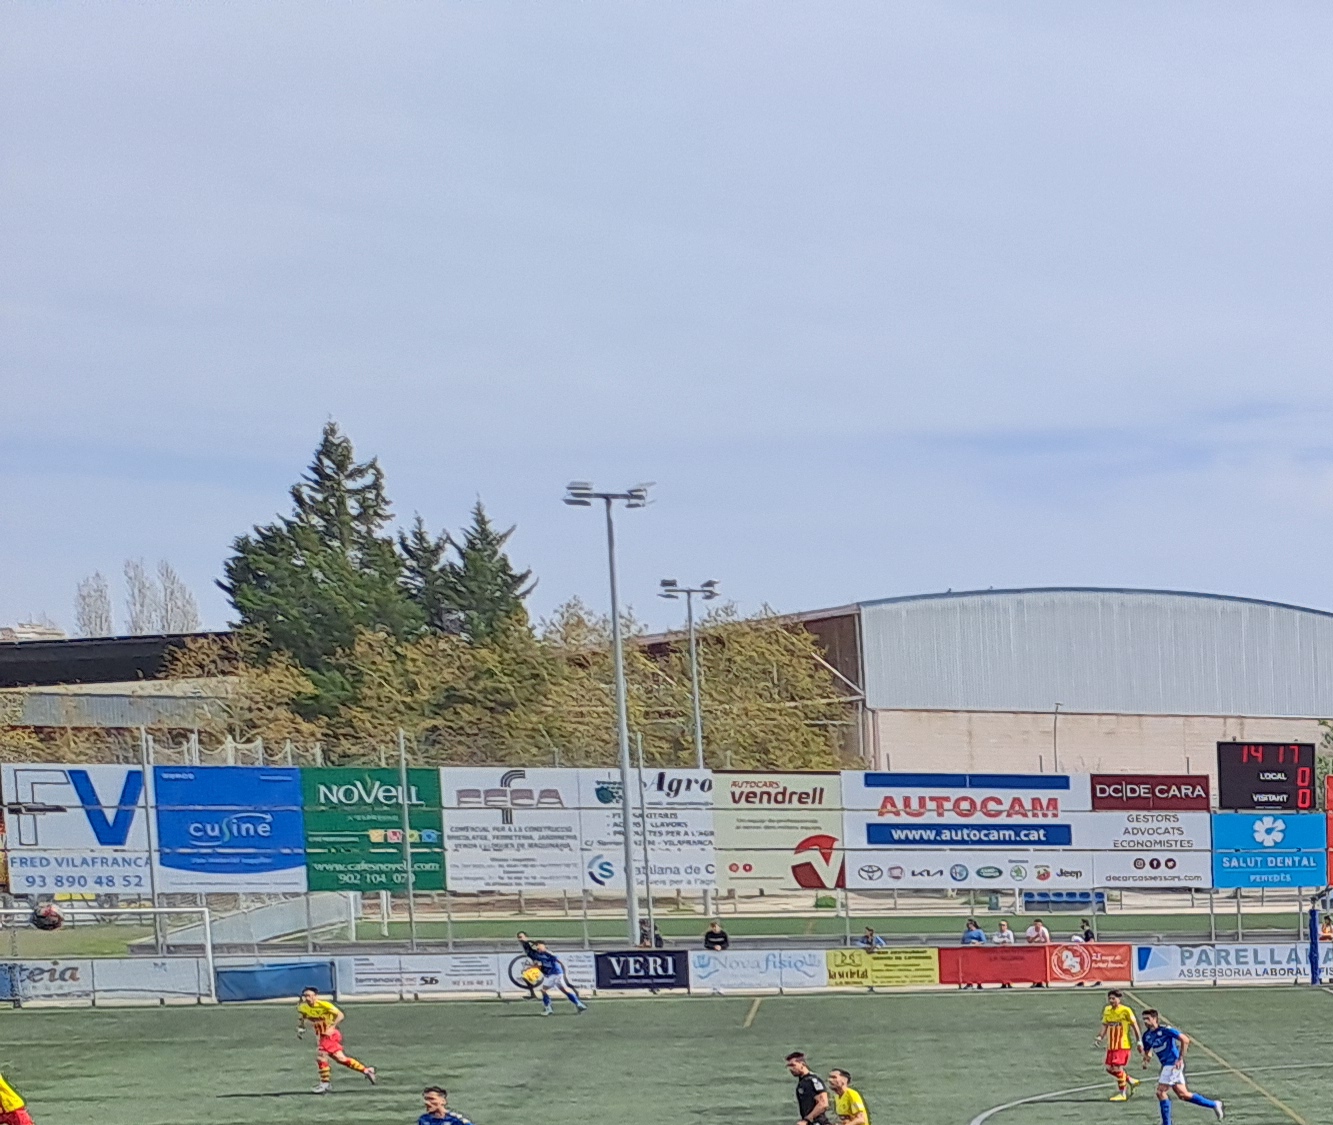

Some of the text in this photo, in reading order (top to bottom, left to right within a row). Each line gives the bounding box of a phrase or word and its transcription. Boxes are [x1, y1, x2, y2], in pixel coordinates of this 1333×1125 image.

[730, 786, 825, 805] vendrell
[1155, 785, 1206, 798] CARA
[877, 796, 1059, 819] AUTOCAM
[1127, 814, 1180, 823] GESTORS
[890, 827, 1047, 841] www.autocam.cat
[1123, 827, 1184, 836] ADVOCATS
[1113, 840, 1193, 848] ECONOMISTES
[11, 856, 51, 868] FRED
[1222, 857, 1317, 867] SALUT DENTAL
[25, 875, 47, 887] 93
[54, 875, 87, 887] 890
[94, 875, 115, 887] 48
[1178, 967, 1252, 977] ASSESSORIA
[1255, 967, 1310, 977] LABORAL
